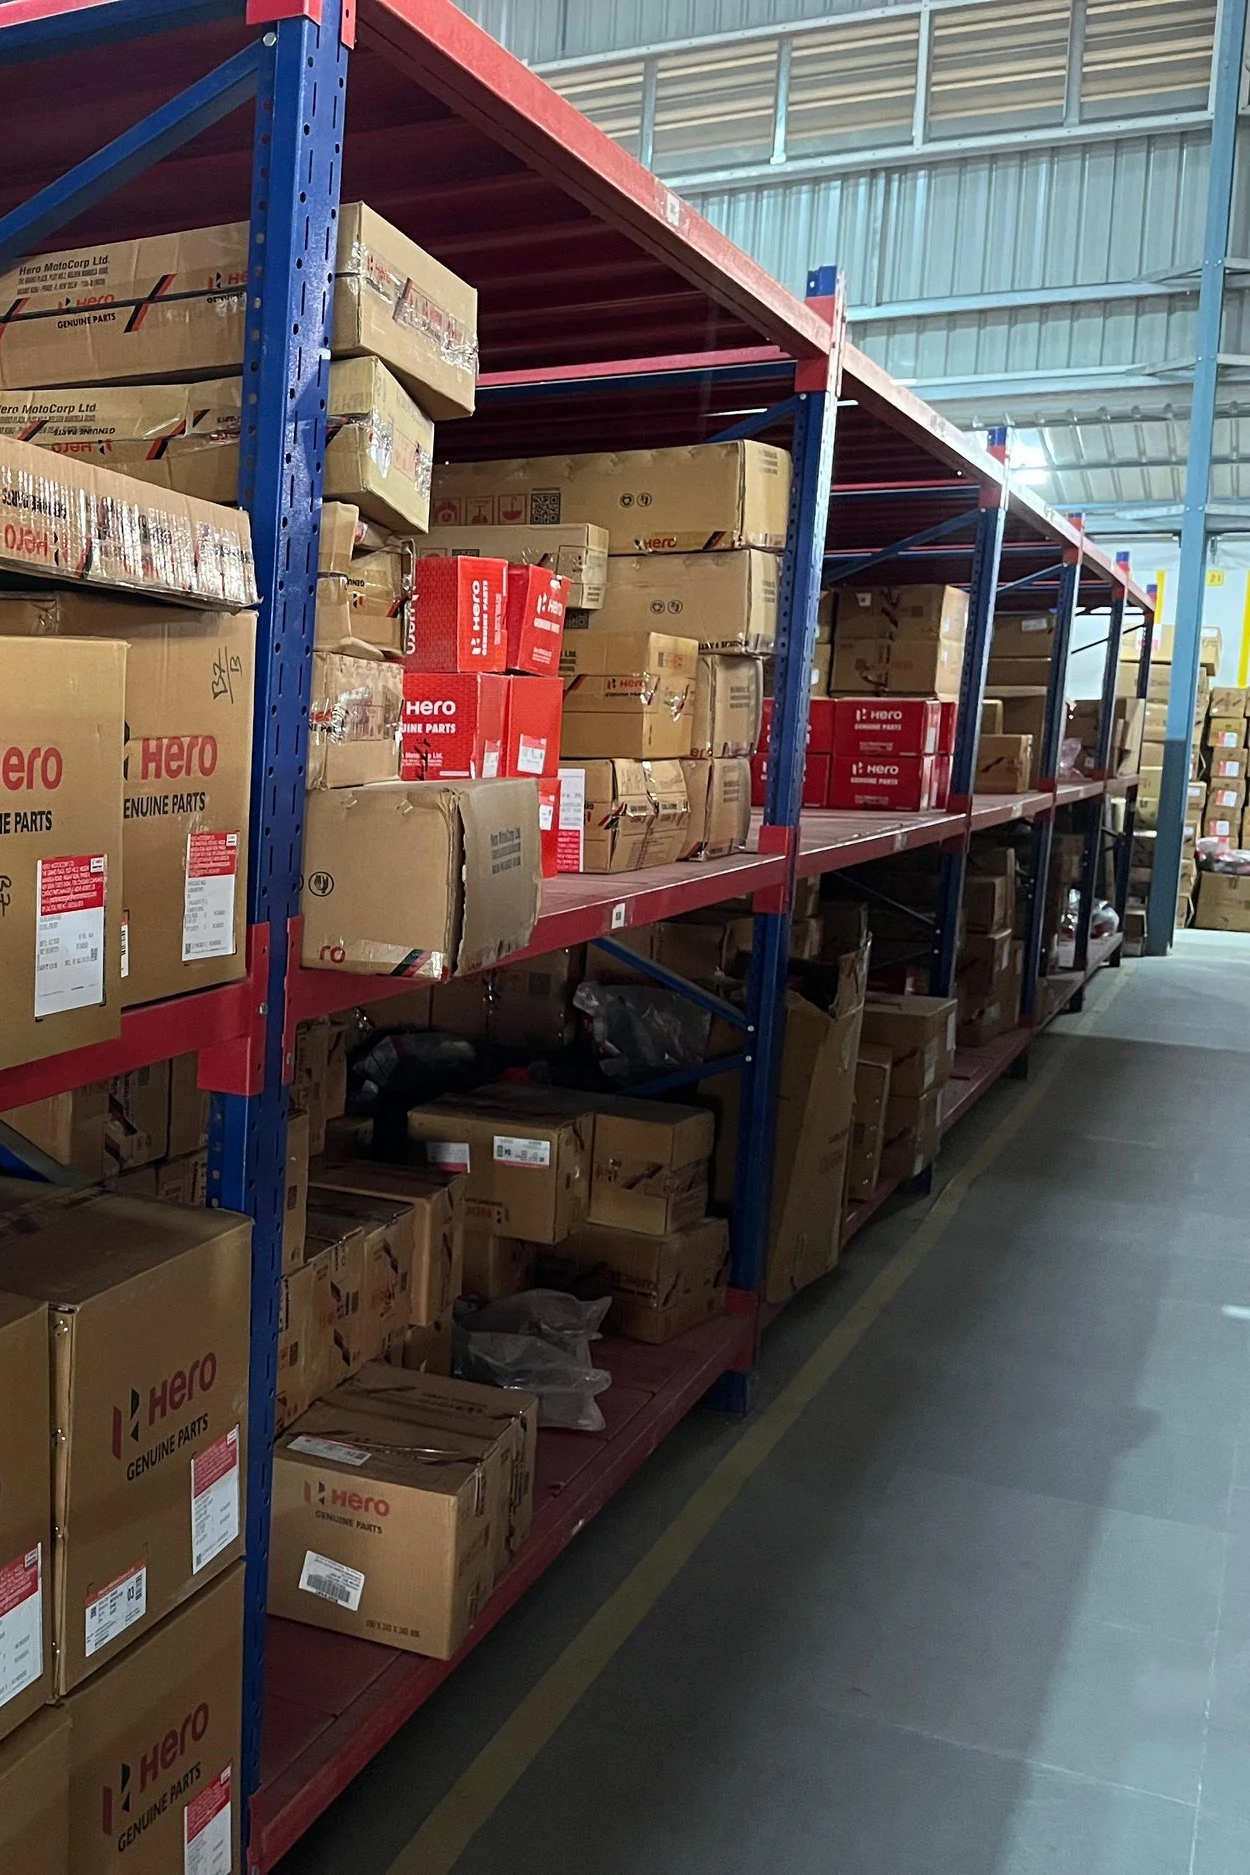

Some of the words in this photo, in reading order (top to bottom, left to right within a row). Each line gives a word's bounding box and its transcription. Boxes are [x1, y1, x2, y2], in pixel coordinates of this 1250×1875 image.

[19, 266, 41, 276] Hero
[44, 259, 89, 272] MotoCorp
[58, 316, 91, 329] GENUINE
[93, 313, 116, 324] PARTS
[22, 404, 75, 415] MotoCorp
[4, 524, 48, 557] Hero
[472, 580, 481, 631] Hero
[406, 700, 456, 715] Hero
[870, 710, 902, 720] Hero
[426, 723, 456, 734] PARTS
[141, 735, 218, 780] Hero
[867, 764, 899, 774] Hero
[172, 791, 206, 814] PARTS
[14, 810, 52, 832] PARTS
[149, 1352, 217, 1426] Hero
[126, 1433, 175, 1481] GENUINE
[177, 1412, 209, 1450] PARTS
[331, 1488, 391, 1517] Hero
[315, 1510, 354, 1528] GENUINE
[356, 1520, 383, 1535] PARTS
[140, 1702, 209, 1794] Hero
[118, 1793, 167, 1852] GENUINE
[170, 1761, 202, 1805] PARTS
